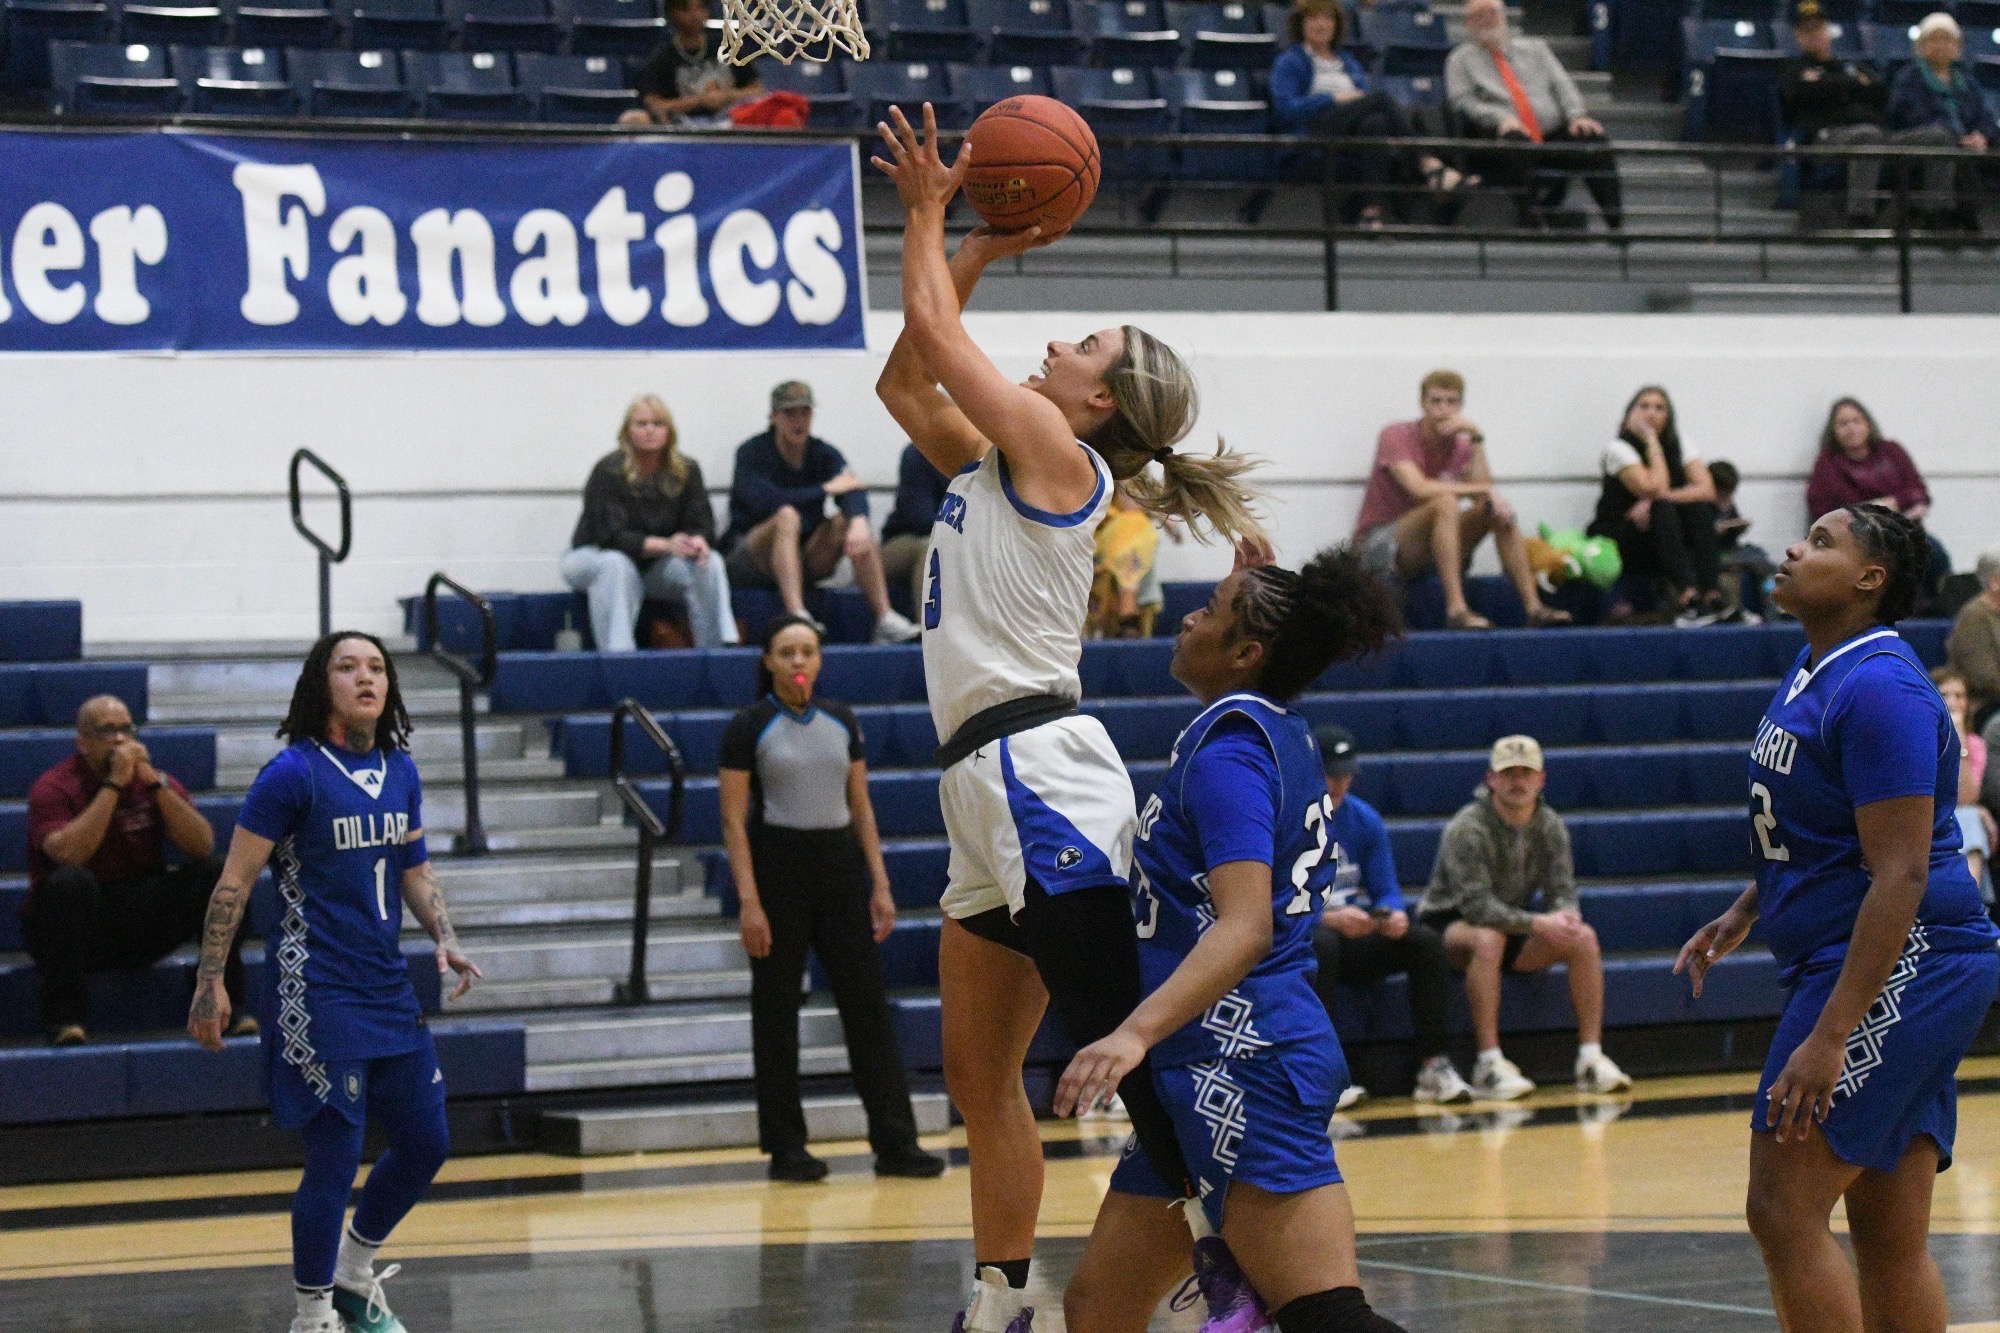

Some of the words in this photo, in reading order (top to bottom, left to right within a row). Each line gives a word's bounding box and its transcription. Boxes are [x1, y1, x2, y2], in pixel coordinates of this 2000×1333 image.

[0, 201, 168, 326] er
[232, 163, 848, 328] Fanatics
[924, 547, 942, 631] 3
[1750, 715, 1798, 775] LARD
[332, 812, 409, 850] DILLAR
[1749, 781, 1790, 862] 2
[373, 858, 389, 921] 1
